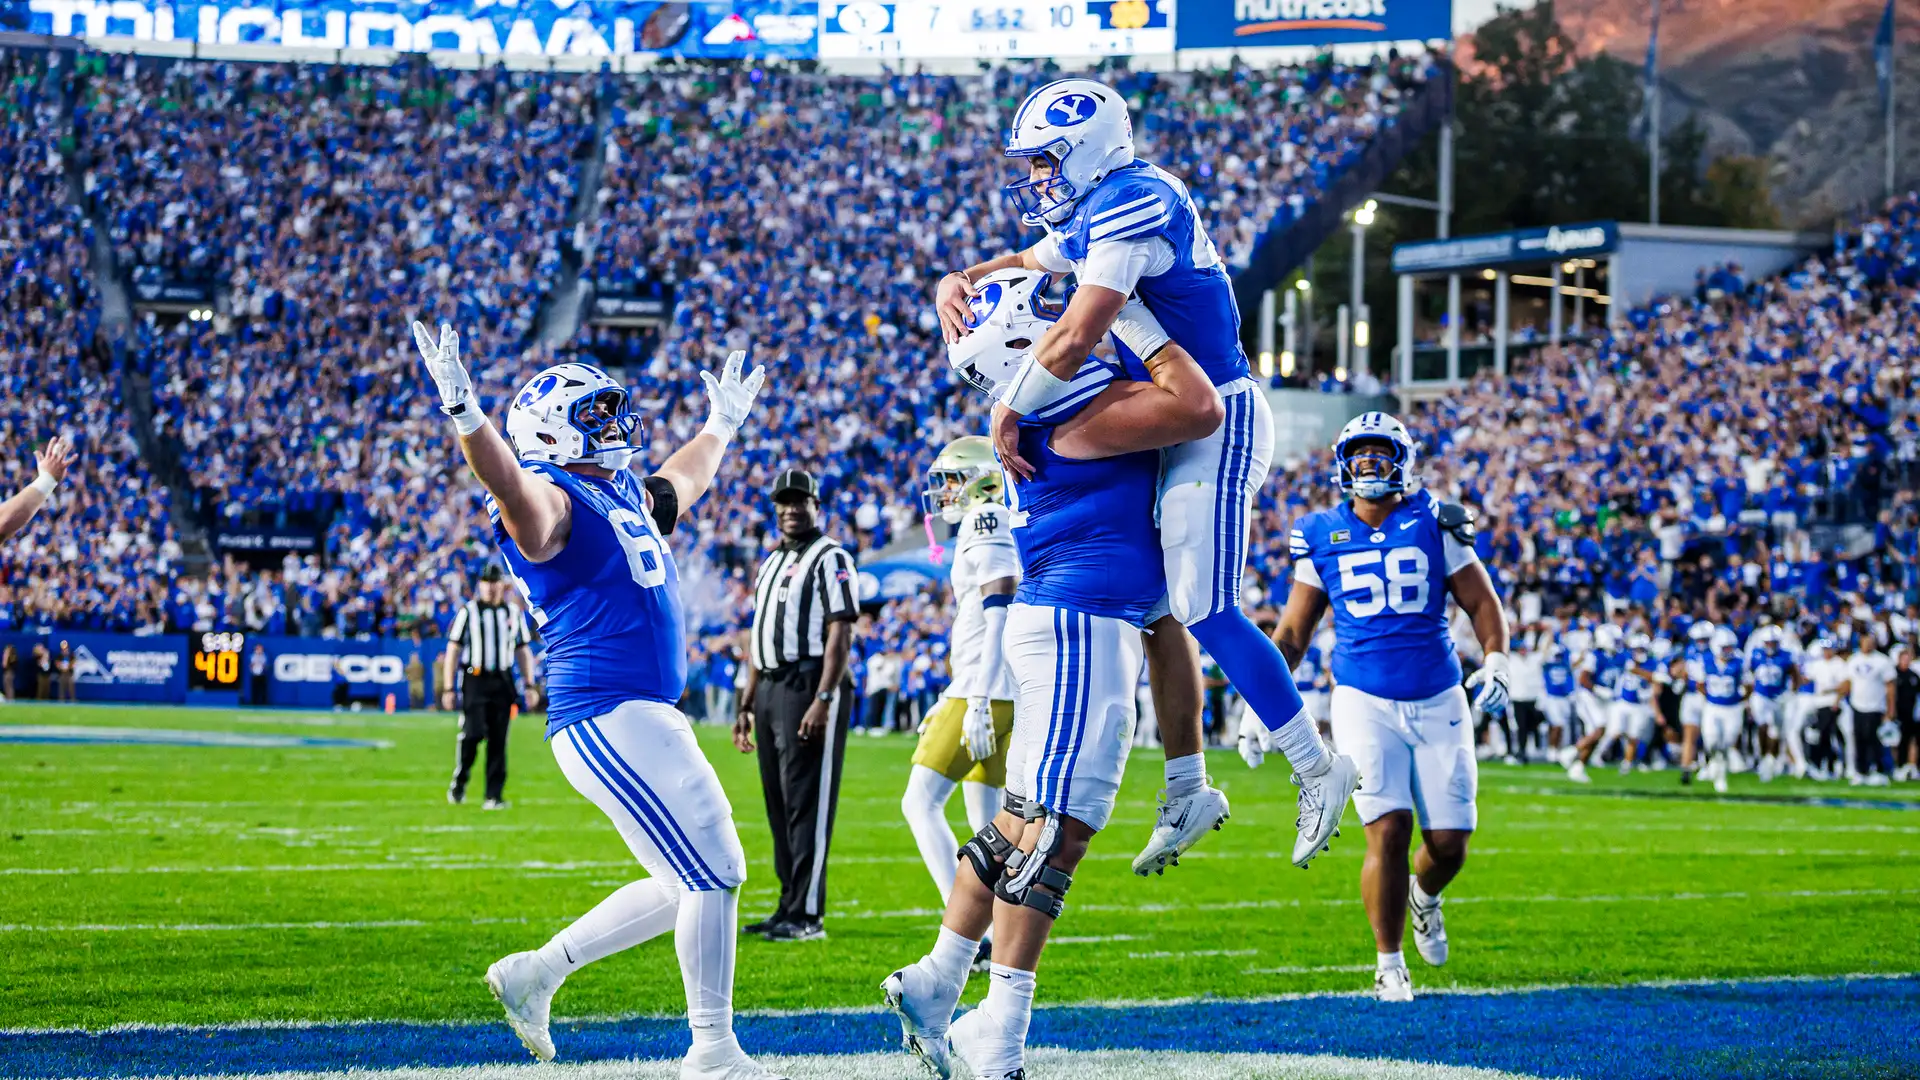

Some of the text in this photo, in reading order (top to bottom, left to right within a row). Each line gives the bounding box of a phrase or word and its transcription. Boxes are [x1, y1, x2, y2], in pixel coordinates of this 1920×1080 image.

[1049, 6, 1074, 28] 10
[1050, 96, 1085, 122] Y
[1337, 547, 1430, 618] 58
[195, 650, 238, 683] 40
